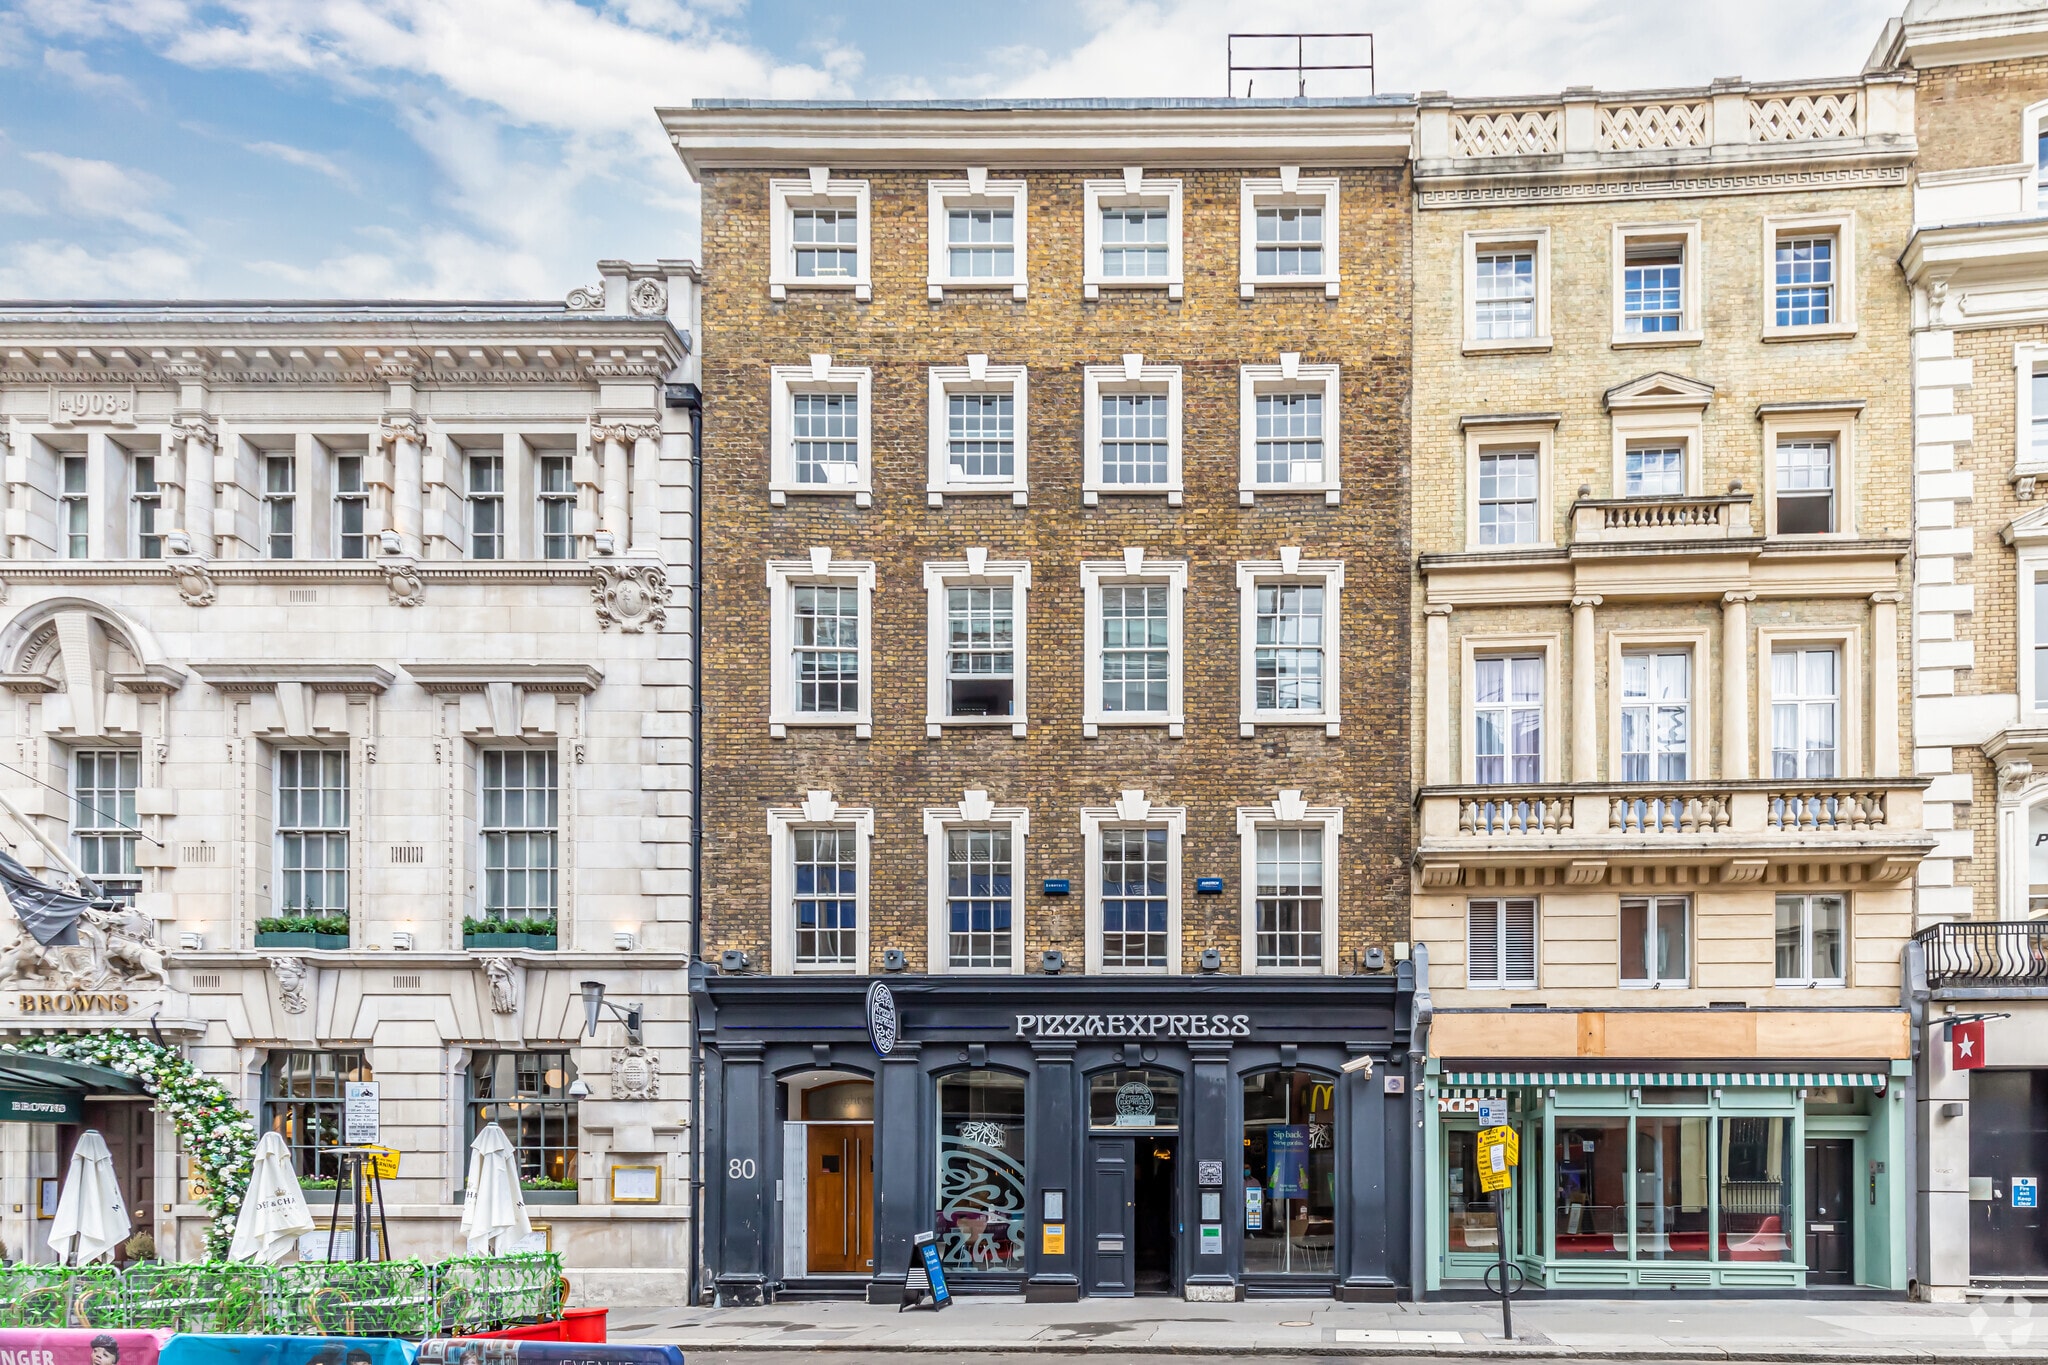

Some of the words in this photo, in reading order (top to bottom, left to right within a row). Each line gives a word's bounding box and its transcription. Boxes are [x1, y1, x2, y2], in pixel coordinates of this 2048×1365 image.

[71, 392, 118, 417] 1908
[19, 994, 130, 1012] BROWNS
[1015, 1014, 1250, 1037] PIZZAEXPRESS
[12, 1101, 67, 1113] BROWNS
[1273, 1130, 1285, 1140] Sip
[1285, 1130, 1303, 1139] back.
[728, 1158, 756, 1179] 80
